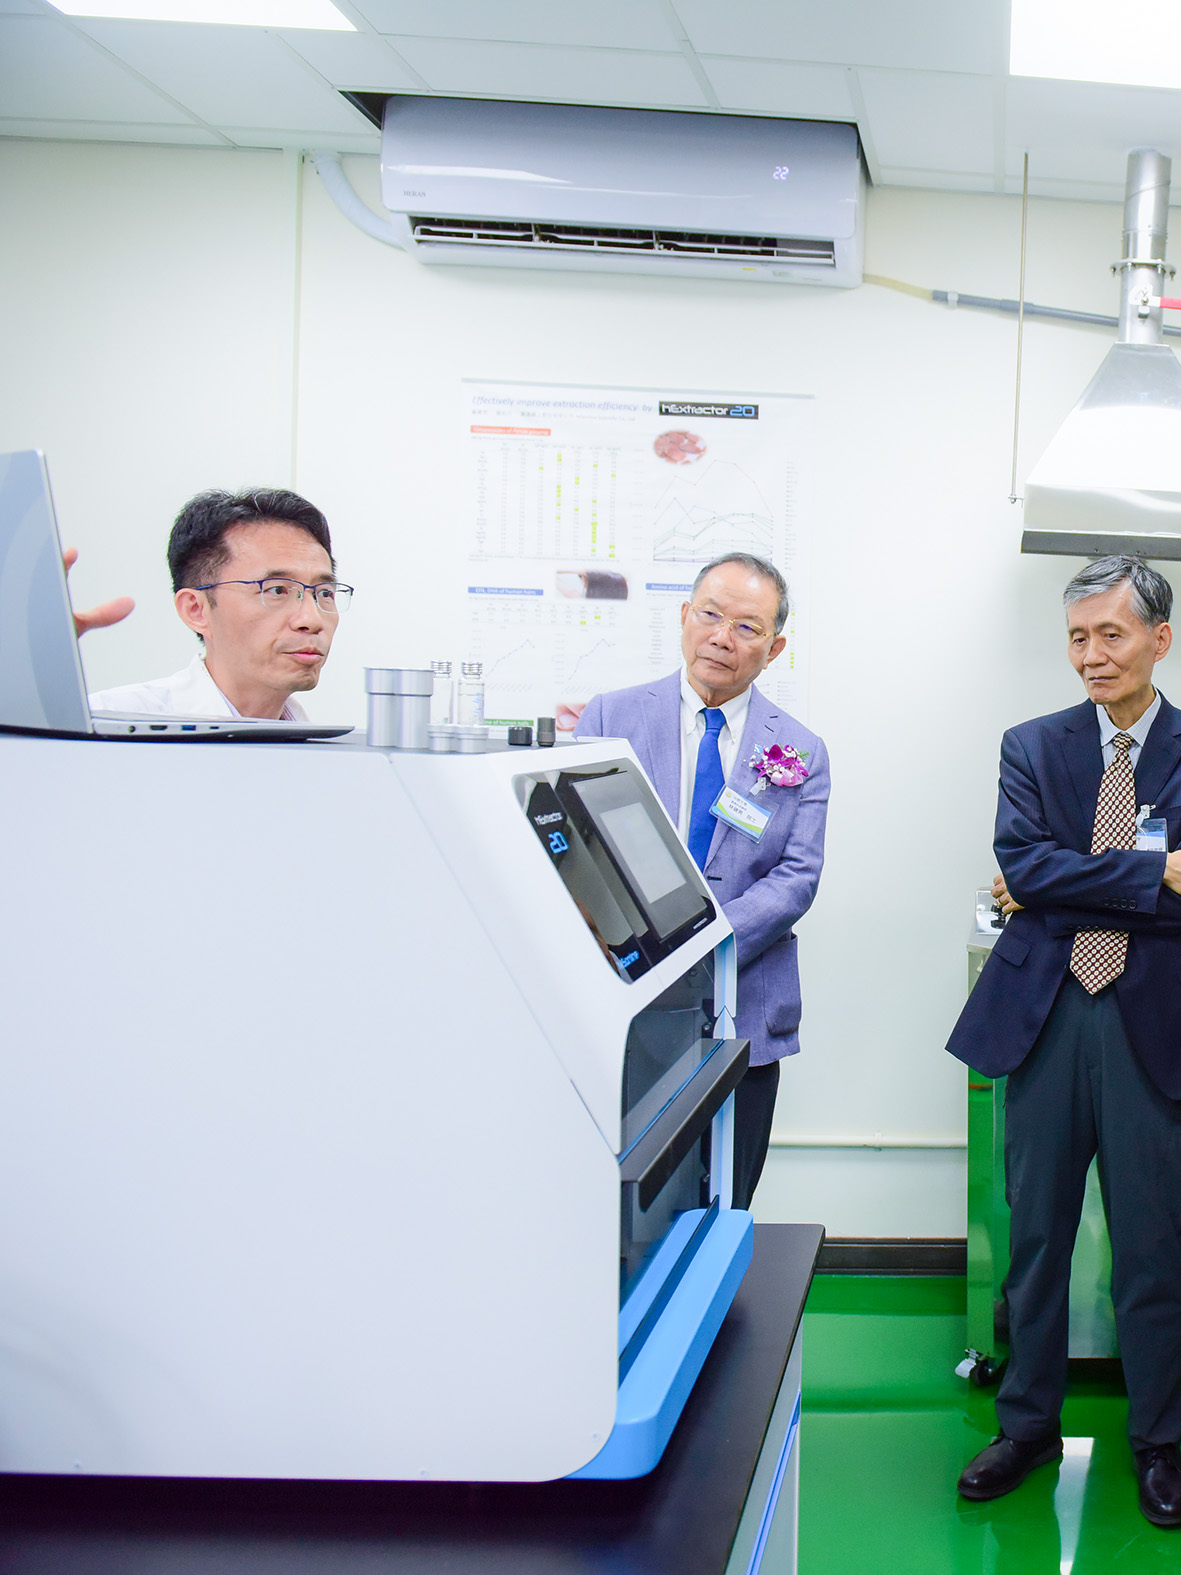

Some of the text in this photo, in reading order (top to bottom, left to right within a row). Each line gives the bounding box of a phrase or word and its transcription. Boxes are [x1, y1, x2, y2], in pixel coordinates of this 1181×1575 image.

[773, 166, 789, 180] 22
[472, 395, 514, 407] Effectively
[516, 398, 551, 409] improve
[553, 399, 596, 410] extraction
[597, 401, 638, 412] efficiency
[642, 402, 653, 412] by
[730, 405, 755, 417] 20
[549, 831, 568, 854] 20
